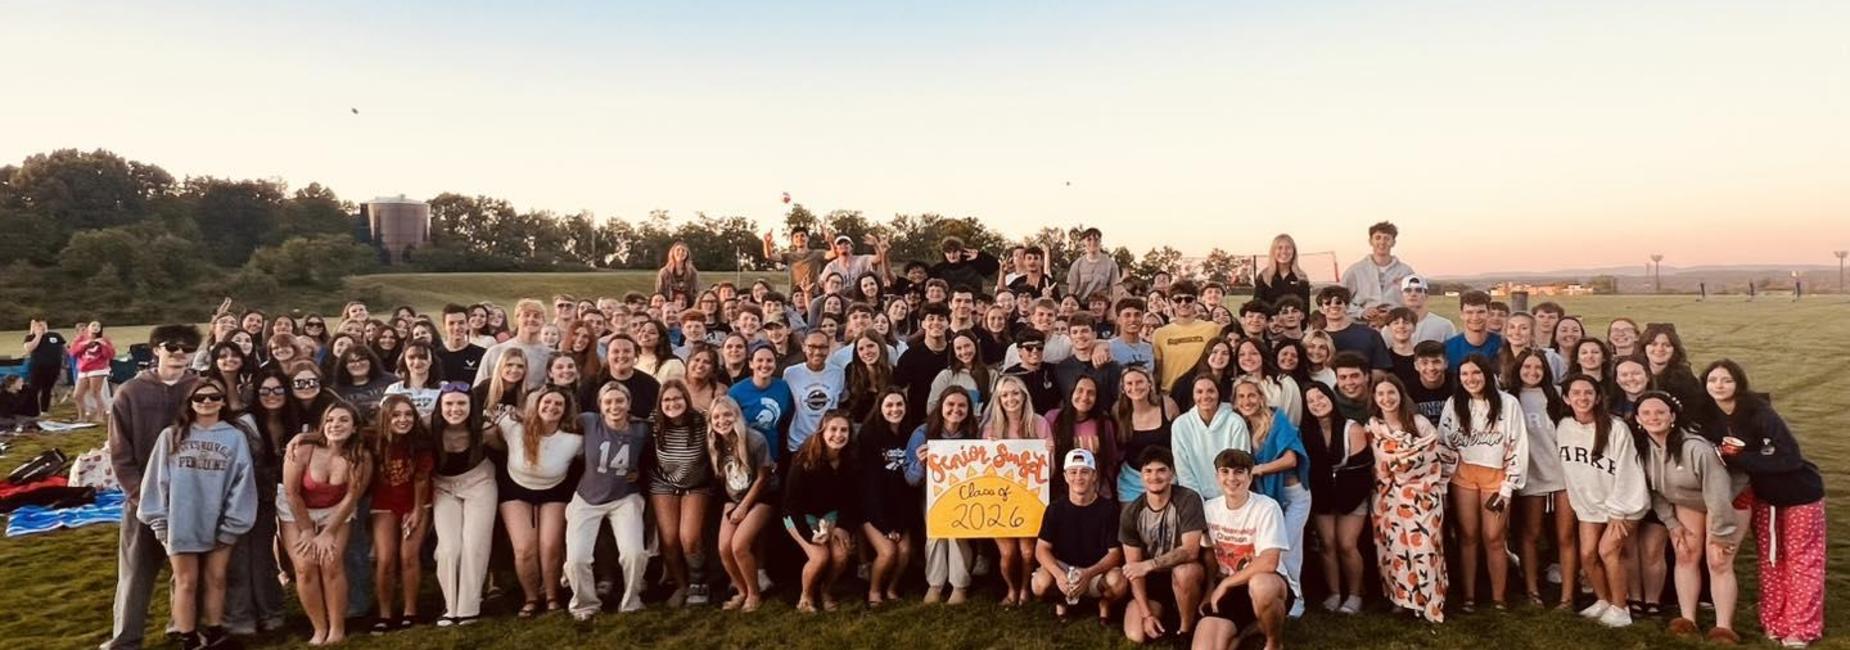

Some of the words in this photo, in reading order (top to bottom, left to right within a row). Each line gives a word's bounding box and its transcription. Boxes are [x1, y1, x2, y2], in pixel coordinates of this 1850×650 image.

[597, 441, 630, 476] 14
[928, 444, 982, 483] Senior
[993, 443, 1048, 484] Sunset
[959, 482, 996, 500] Class
[998, 485, 1013, 502] of
[951, 502, 1025, 530] 2026
